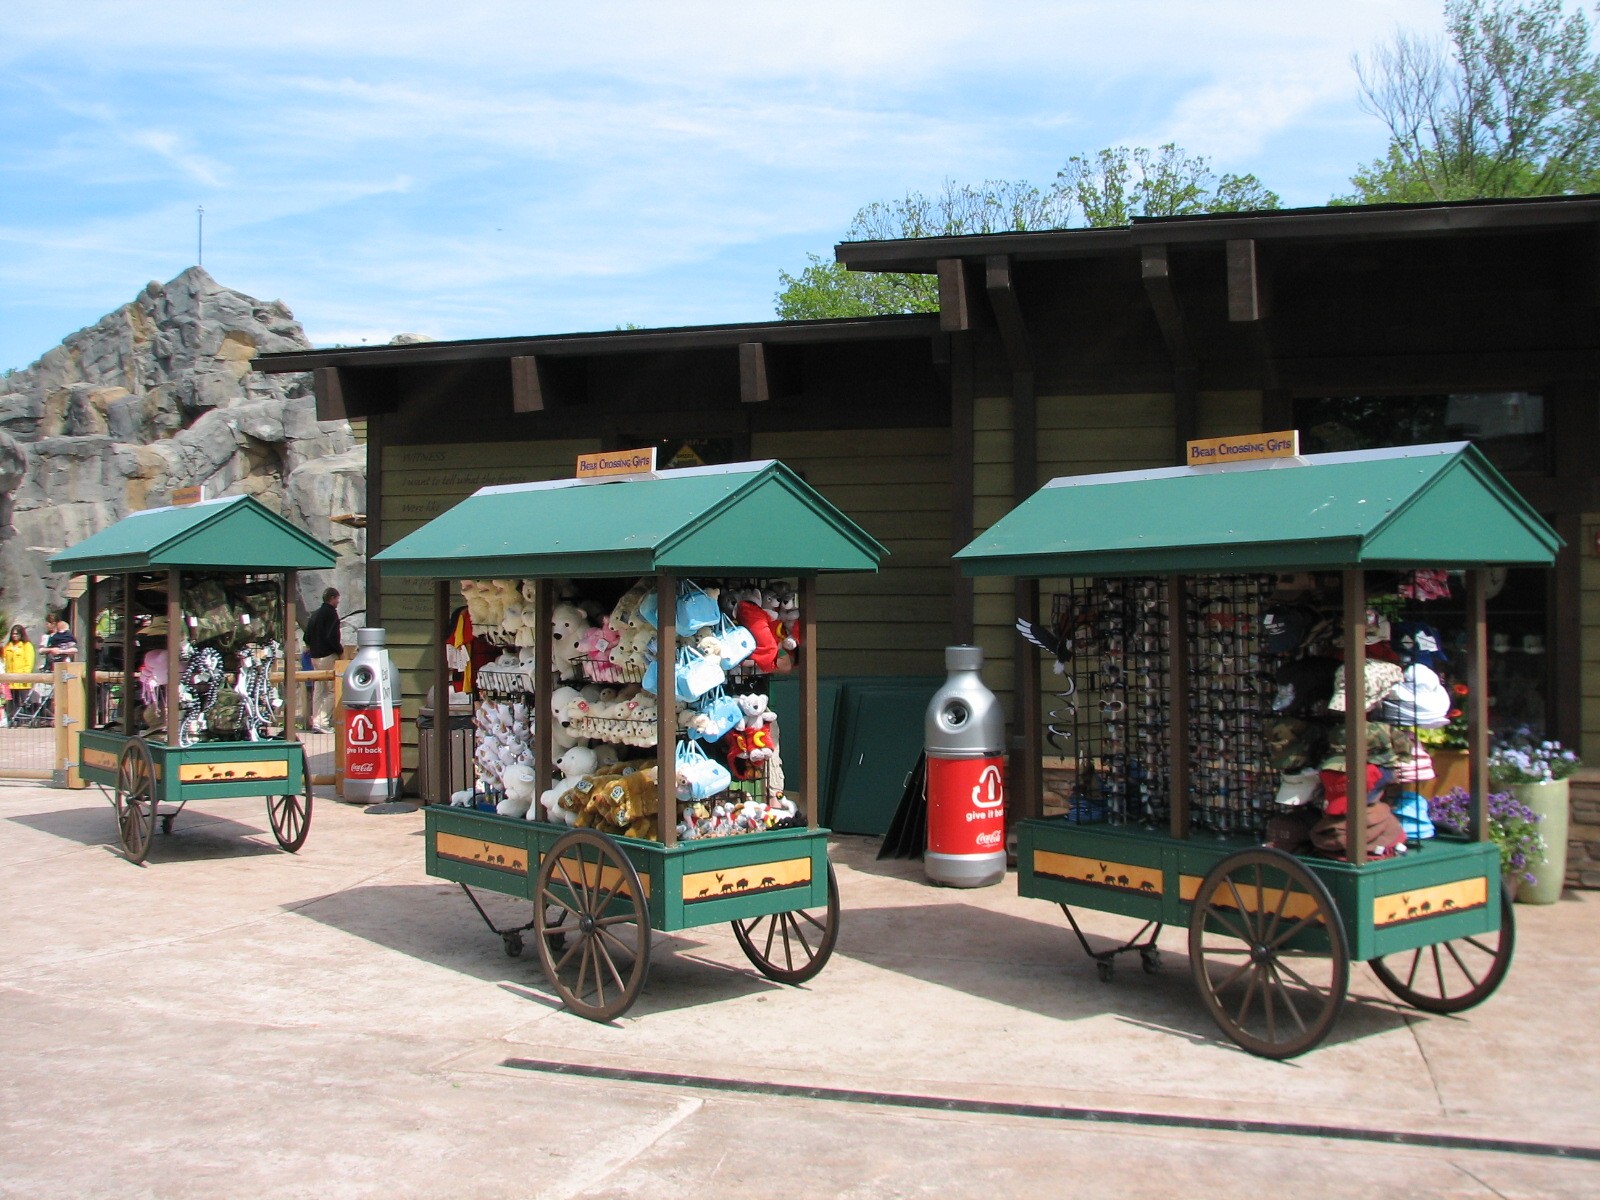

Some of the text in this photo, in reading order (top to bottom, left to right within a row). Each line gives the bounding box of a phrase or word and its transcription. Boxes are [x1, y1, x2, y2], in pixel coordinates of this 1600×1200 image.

[402, 452, 446, 463] WITNESS
[966, 811, 986, 822] give
[988, 809, 994, 818] it
